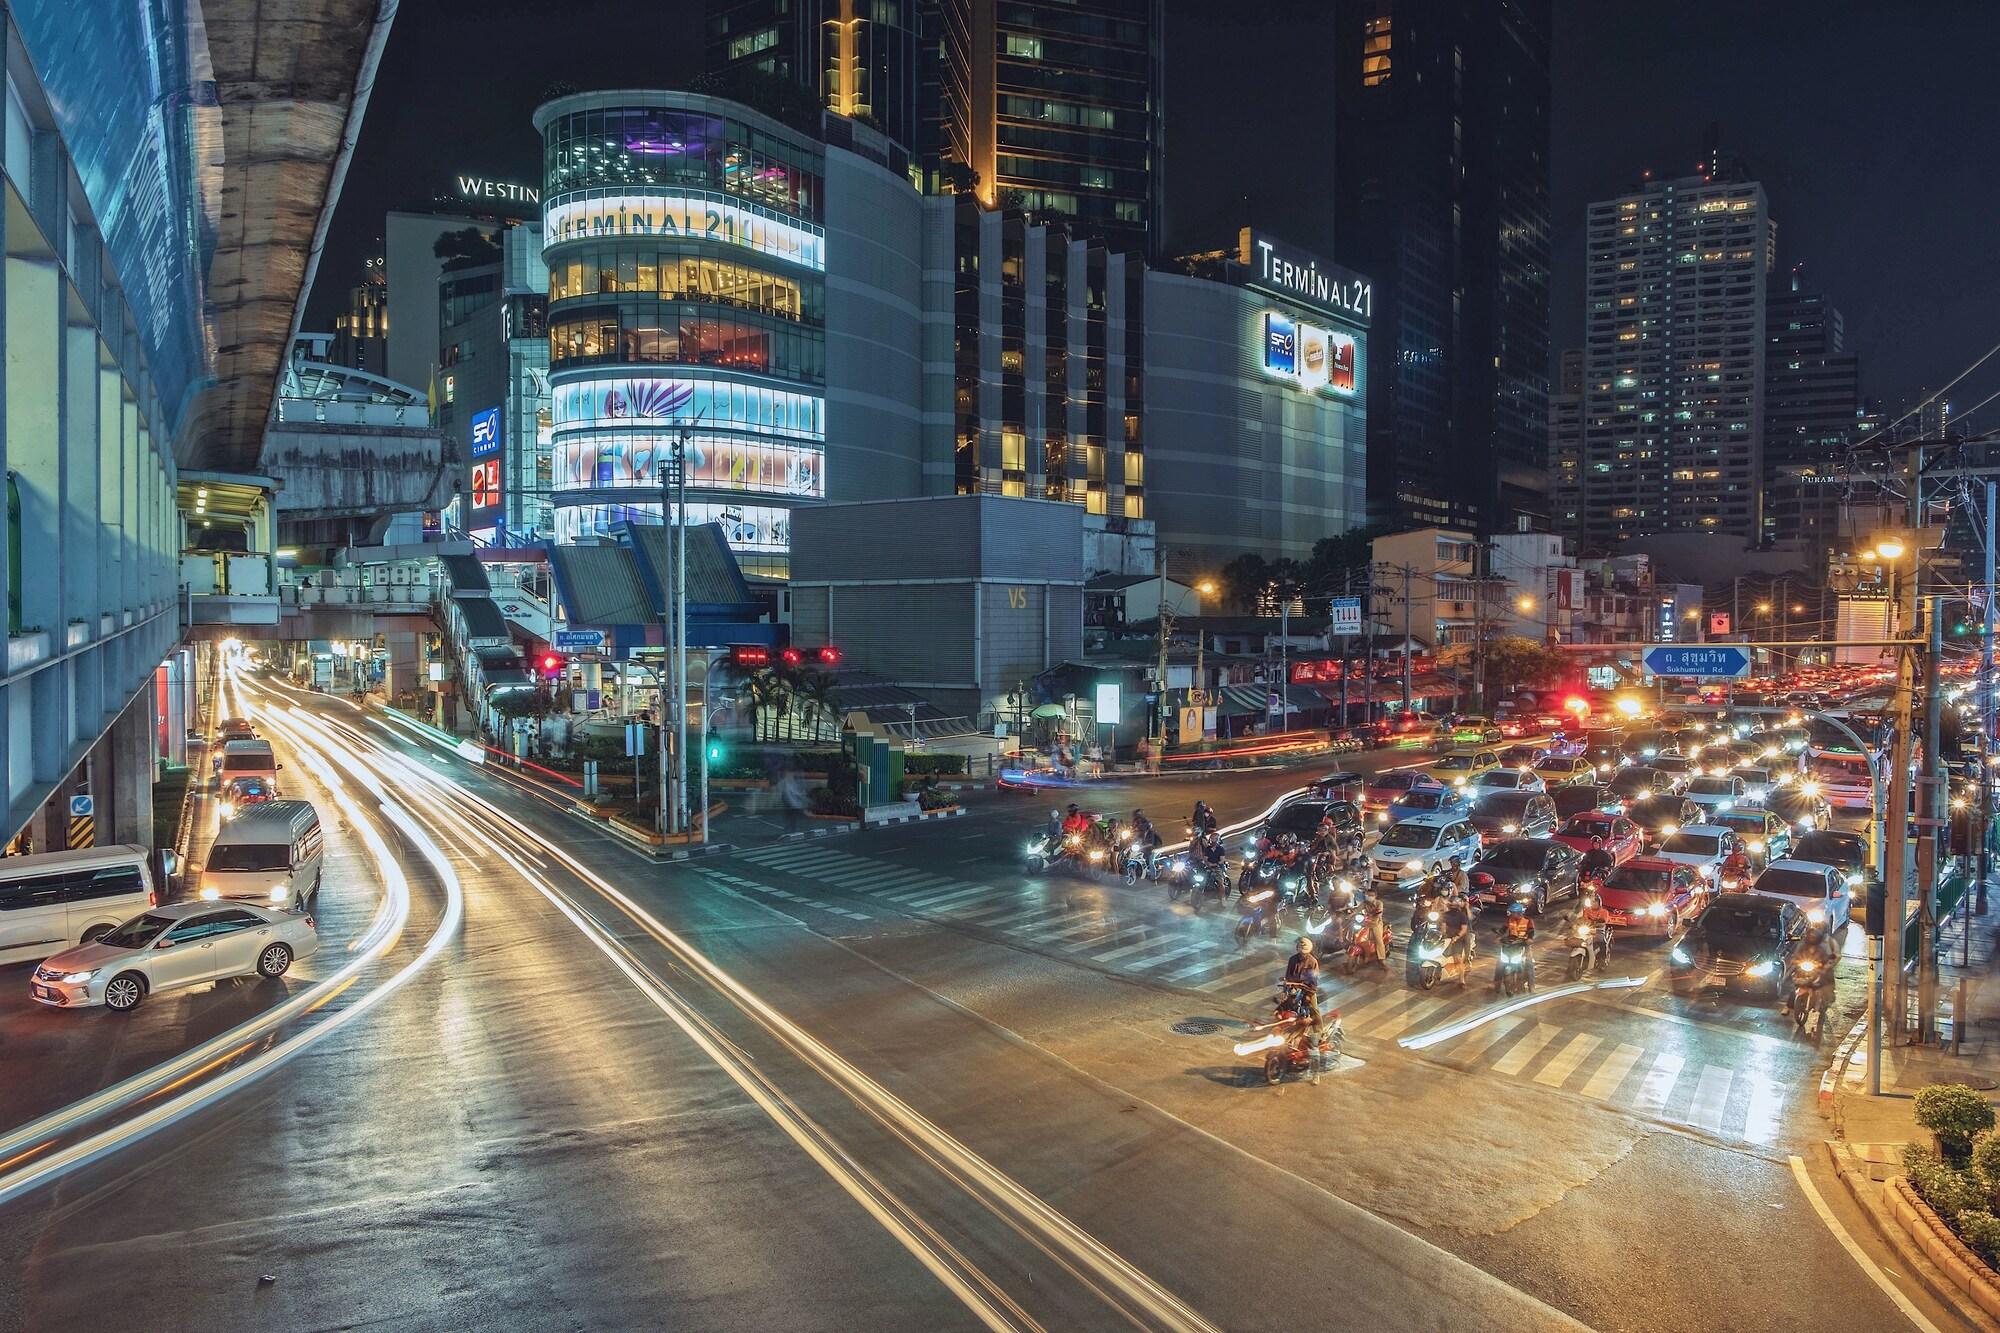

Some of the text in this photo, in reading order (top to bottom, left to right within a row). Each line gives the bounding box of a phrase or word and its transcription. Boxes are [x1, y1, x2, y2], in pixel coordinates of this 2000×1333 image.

[458, 176, 539, 204] WESTIN
[1008, 588, 1026, 608] VS
[1681, 649, 1726, 666] สุขุมวิท
